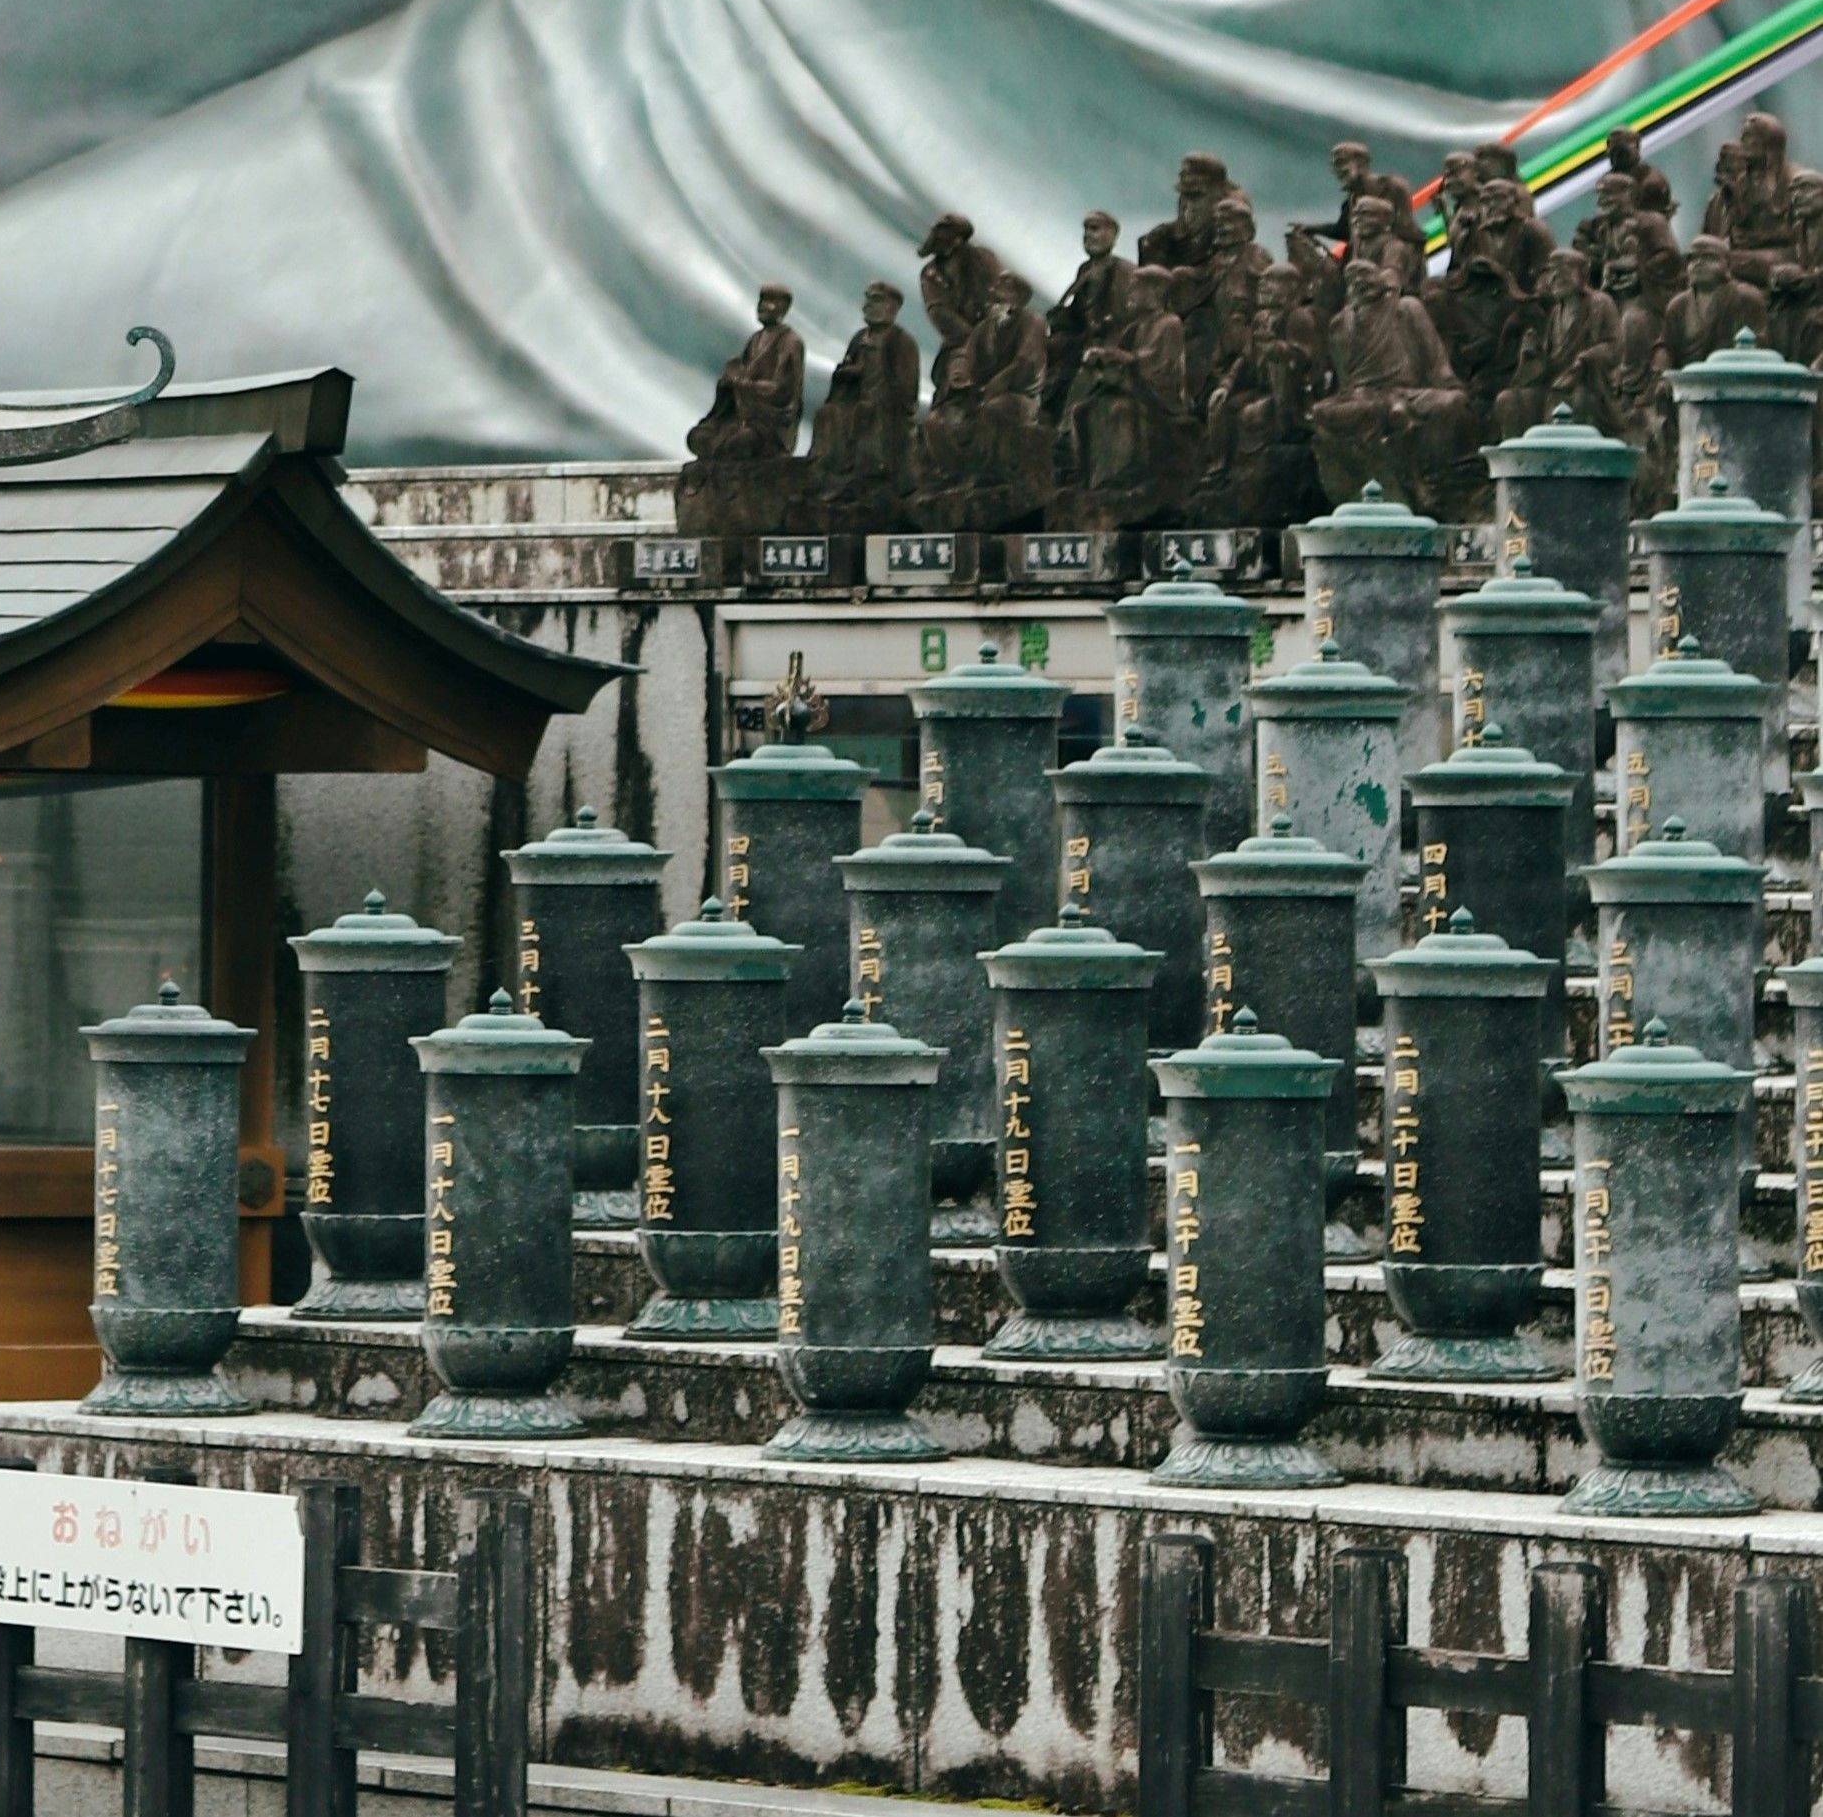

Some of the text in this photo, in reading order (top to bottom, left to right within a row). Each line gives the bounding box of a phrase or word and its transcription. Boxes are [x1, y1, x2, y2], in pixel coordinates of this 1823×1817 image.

[1312, 587, 1335, 660] 七月
[1067, 836, 1091, 915] 四月
[1210, 932, 1233, 1033] 三月十
[51, 1500, 212, 1556] おねがい
